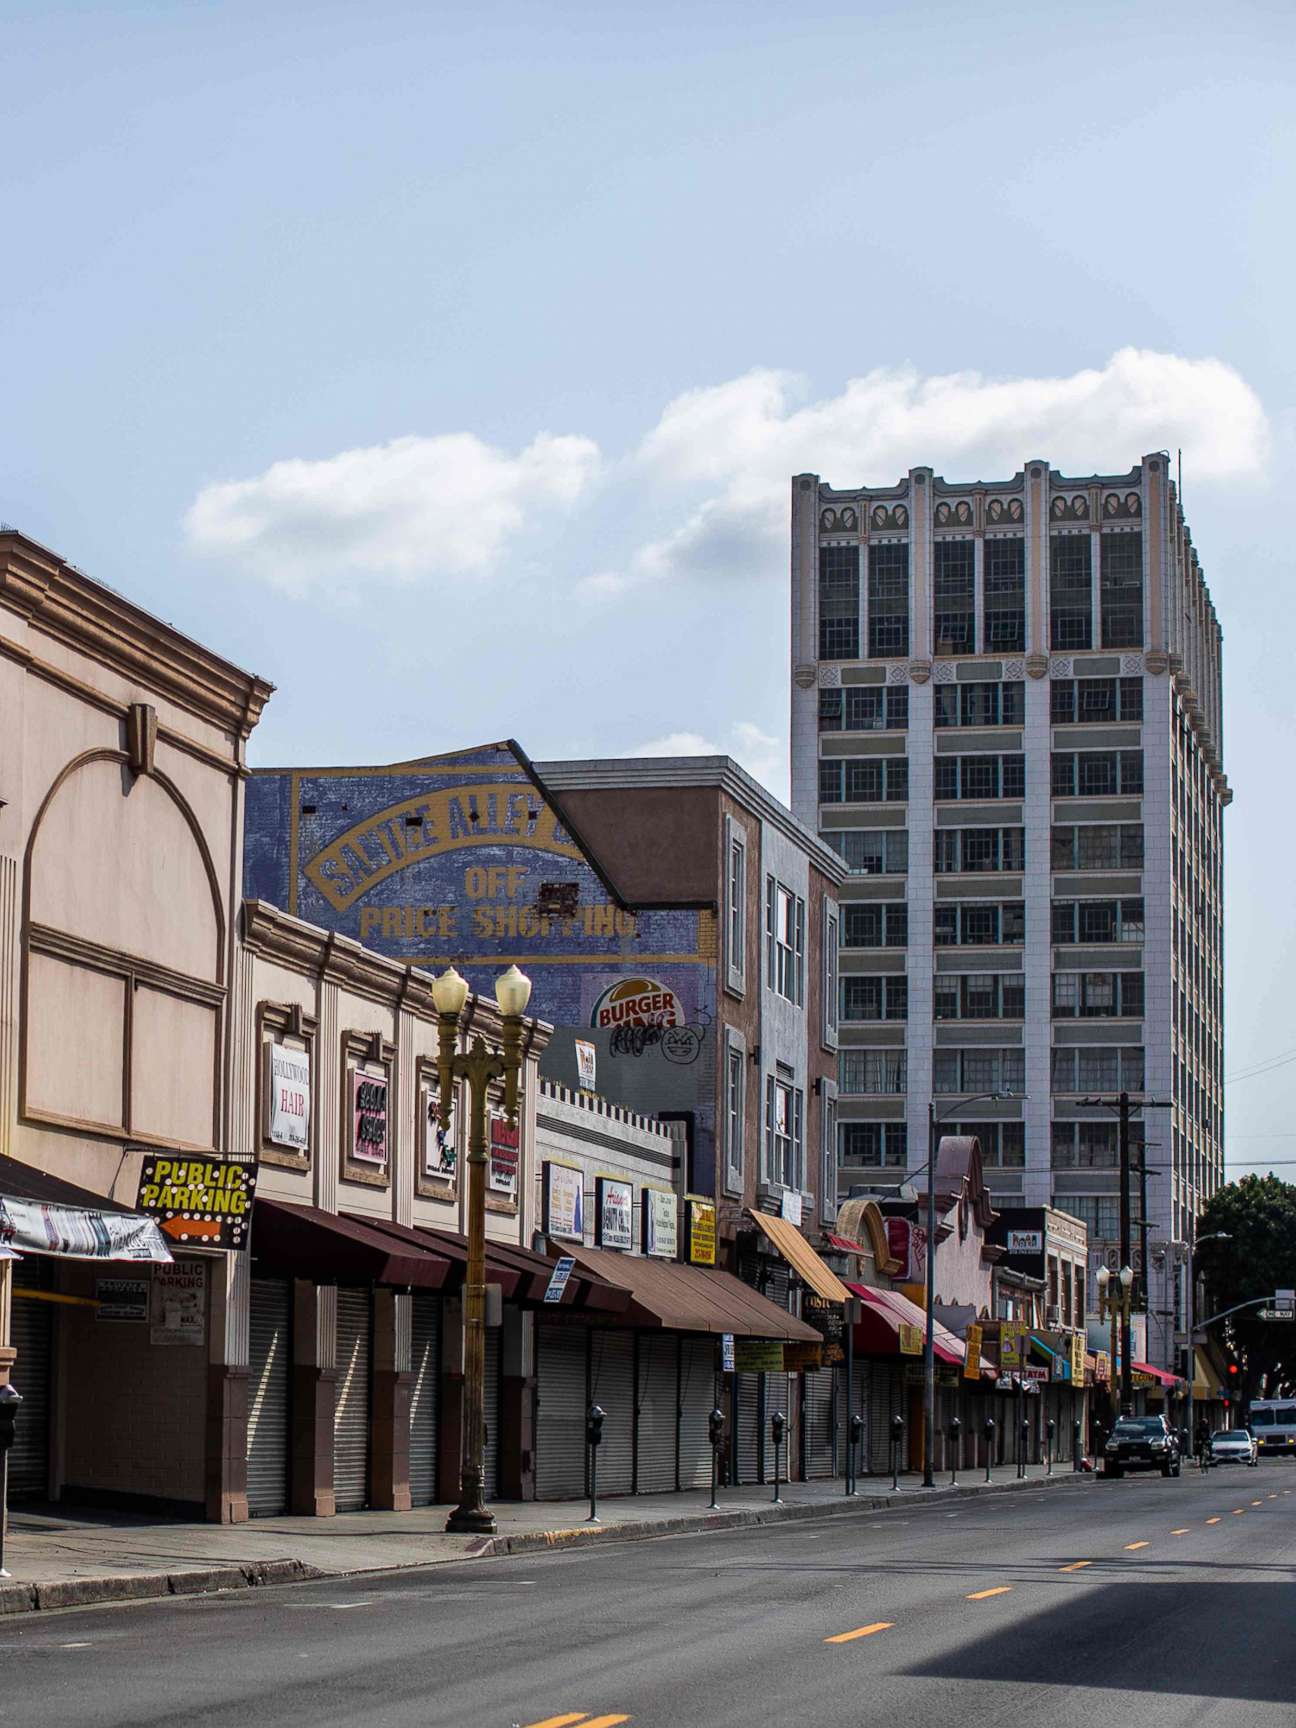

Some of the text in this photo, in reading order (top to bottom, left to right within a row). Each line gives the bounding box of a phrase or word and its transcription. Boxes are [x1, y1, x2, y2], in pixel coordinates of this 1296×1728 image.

[318, 804, 439, 897] SANTEE
[447, 792, 545, 840] ALLEY
[463, 865, 529, 898] OFF
[359, 906, 456, 938] PRICE
[599, 992, 676, 1027] BURGER
[280, 1088, 304, 1117] HAIR
[153, 1160, 244, 1189] PUBLIC
[142, 1184, 247, 1214] PARKING
[153, 1263, 204, 1276] PUBLIC
[153, 1276, 204, 1289] PARKING
[1027, 1371, 1046, 1380] ATM
